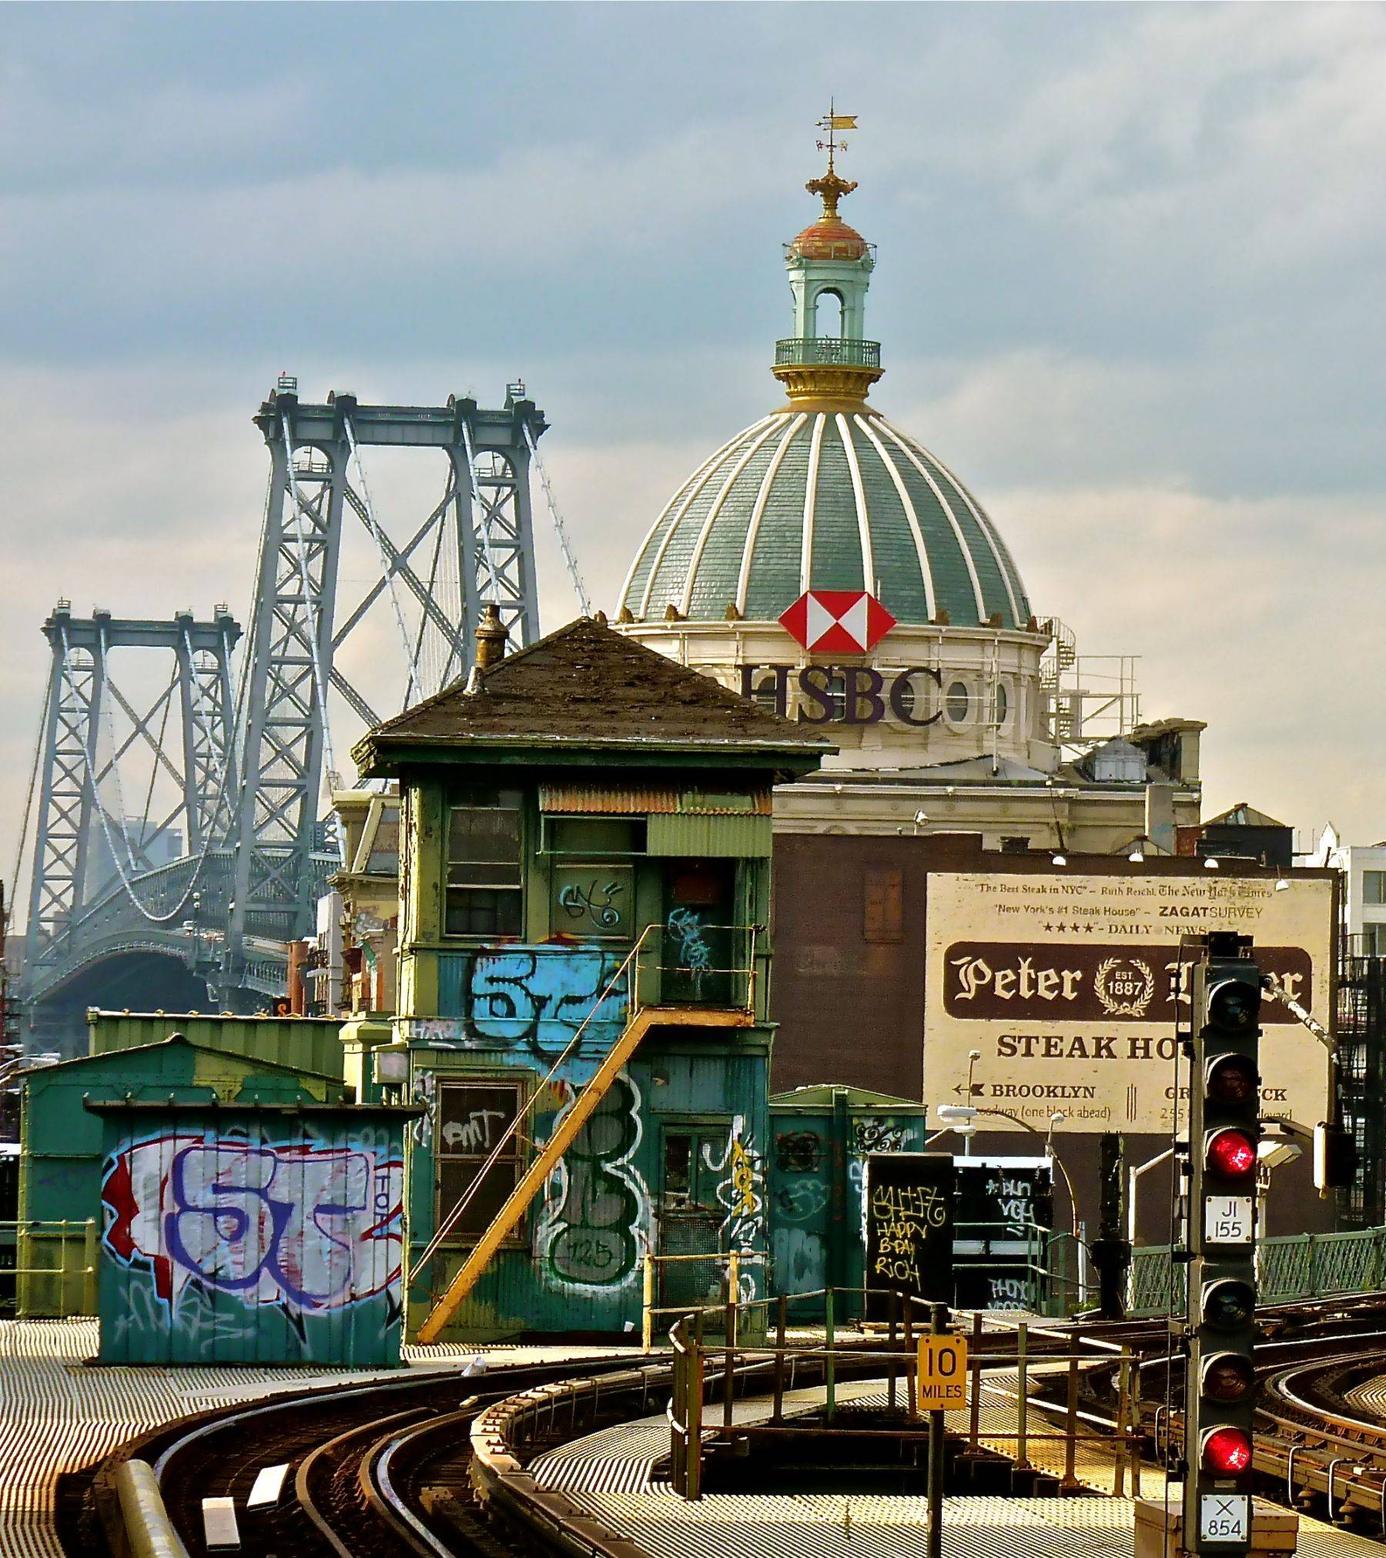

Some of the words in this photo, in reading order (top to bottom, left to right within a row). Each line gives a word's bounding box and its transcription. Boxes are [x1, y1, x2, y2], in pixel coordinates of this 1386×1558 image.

[742, 664, 943, 727] HSBC
[1000, 884, 1019, 893] Best
[1021, 884, 1047, 894] Steak
[1050, 885, 1059, 894] in
[1101, 887, 1123, 896] Ruth
[1158, 885, 1178, 897] The
[1181, 885, 1206, 897] New
[1023, 905, 1054, 914] York's
[1057, 905, 1068, 914] #1
[1072, 906, 1101, 916] Steak
[1108, 924, 1153, 935] DAILY
[1164, 925, 1207, 936] NEWS
[950, 956, 1082, 1001] Peter
[1107, 981, 1144, 996] 1887
[996, 1034, 1118, 1060] STEAK
[990, 1084, 1096, 1099] BROOKLYN
[1021, 1105, 1048, 1121] (one
[1077, 1106, 1111, 1121] ahead)
[877, 1221, 928, 1239] HAPPY
[1215, 1221, 1242, 1238] 155
[928, 1348, 956, 1377] 10
[922, 1384, 962, 1399] MILES
[1208, 1519, 1242, 1536] 854
